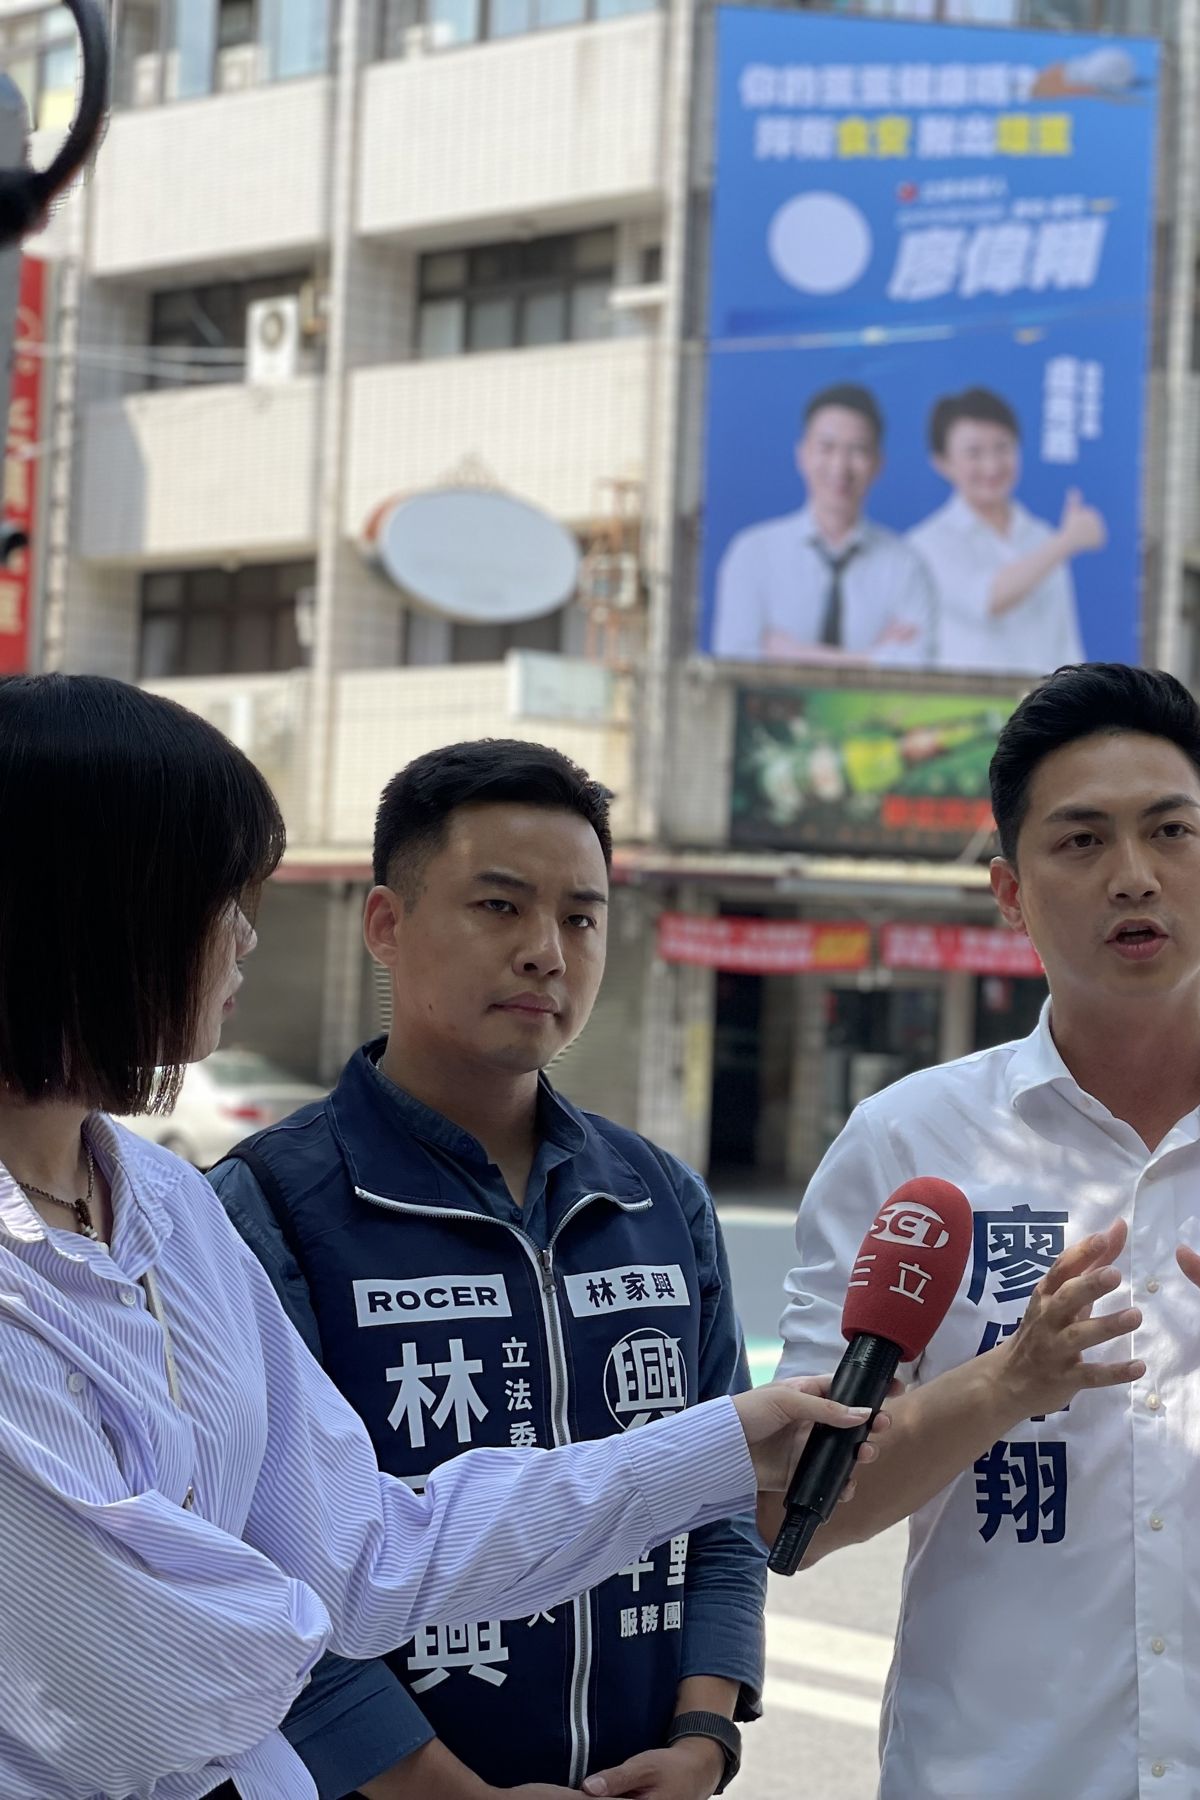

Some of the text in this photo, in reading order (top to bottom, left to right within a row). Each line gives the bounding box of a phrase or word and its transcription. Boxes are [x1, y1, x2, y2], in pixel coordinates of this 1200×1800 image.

[586, 1272, 677, 1309] 林家興
[848, 1254, 932, 1304] 三立
[367, 1285, 500, 1314] ROCER
[967, 1204, 1069, 1544] 廖翔
[620, 1601, 685, 1637] 服務團
